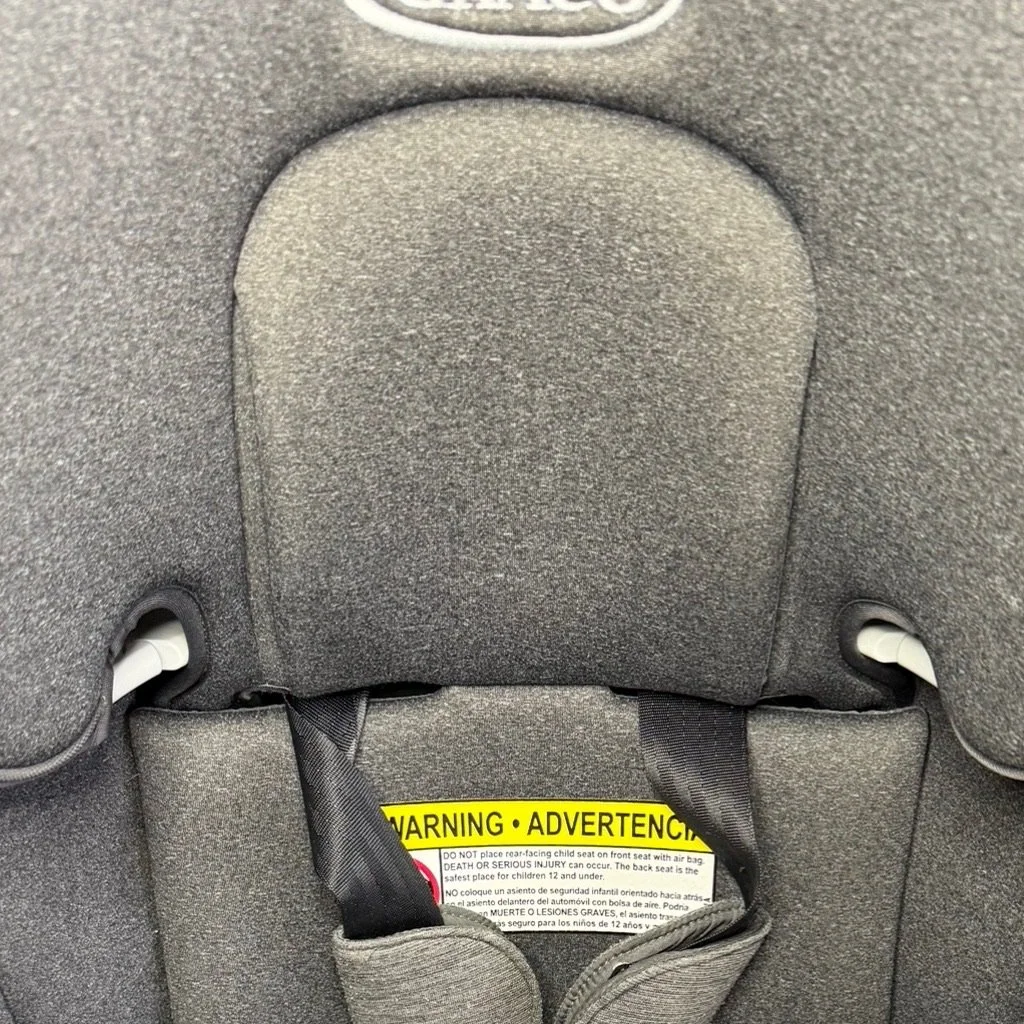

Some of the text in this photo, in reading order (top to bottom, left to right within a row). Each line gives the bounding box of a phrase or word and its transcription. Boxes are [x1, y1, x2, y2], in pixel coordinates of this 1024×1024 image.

[527, 811, 697, 841] ADVERTENCI
[444, 851, 456, 860] DO
[459, 851, 478, 859] NOT
[480, 850, 503, 860] place
[505, 850, 551, 859] rear-facing
[554, 850, 575, 858] child
[577, 851, 595, 859] seat
[610, 851, 631, 860] front
[633, 853, 651, 861] seat
[653, 853, 671, 862] with
[674, 854, 685, 862] air
[444, 861, 473, 871] DEATH
[476, 860, 489, 869] OR
[492, 860, 532, 869] SERIOUS
[534, 861, 566, 869] INJURY
[586, 862, 612, 870] occur.
[615, 862, 630, 871] The
[632, 863, 652, 872] back
[676, 865, 683, 874] is
[685, 867, 699, 875] the
[444, 873, 470, 882] safest
[472, 873, 495, 883] place
[497, 872, 509, 880] for
[511, 872, 546, 880] children
[560, 872, 576, 880] and
[579, 873, 605, 881] under.
[445, 889, 458, 897] NO
[460, 888, 492, 897] coloque
[507, 887, 536, 895] asiento
[538, 887, 548, 895] de
[591, 888, 619, 896] infantil
[620, 889, 658, 898] orientado
[660, 891, 681, 899] hacia
[466, 899, 495, 907] asiento
[497, 898, 535, 906] delantero
[537, 897, 549, 905] del
[551, 897, 590, 906] automóvil
[633, 900, 643, 908] de
[490, 908, 525, 917] MUERTE
[537, 908, 579, 916] LESIONES
[580, 909, 618, 918] GRAVES,
[620, 910, 627, 918] el
[628, 911, 658, 920] asiento
[508, 920, 535, 929] seguro
[537, 920, 556, 929] para
[558, 919, 570, 927] los
[573, 919, 596, 927] niños
[599, 920, 609, 928] de
